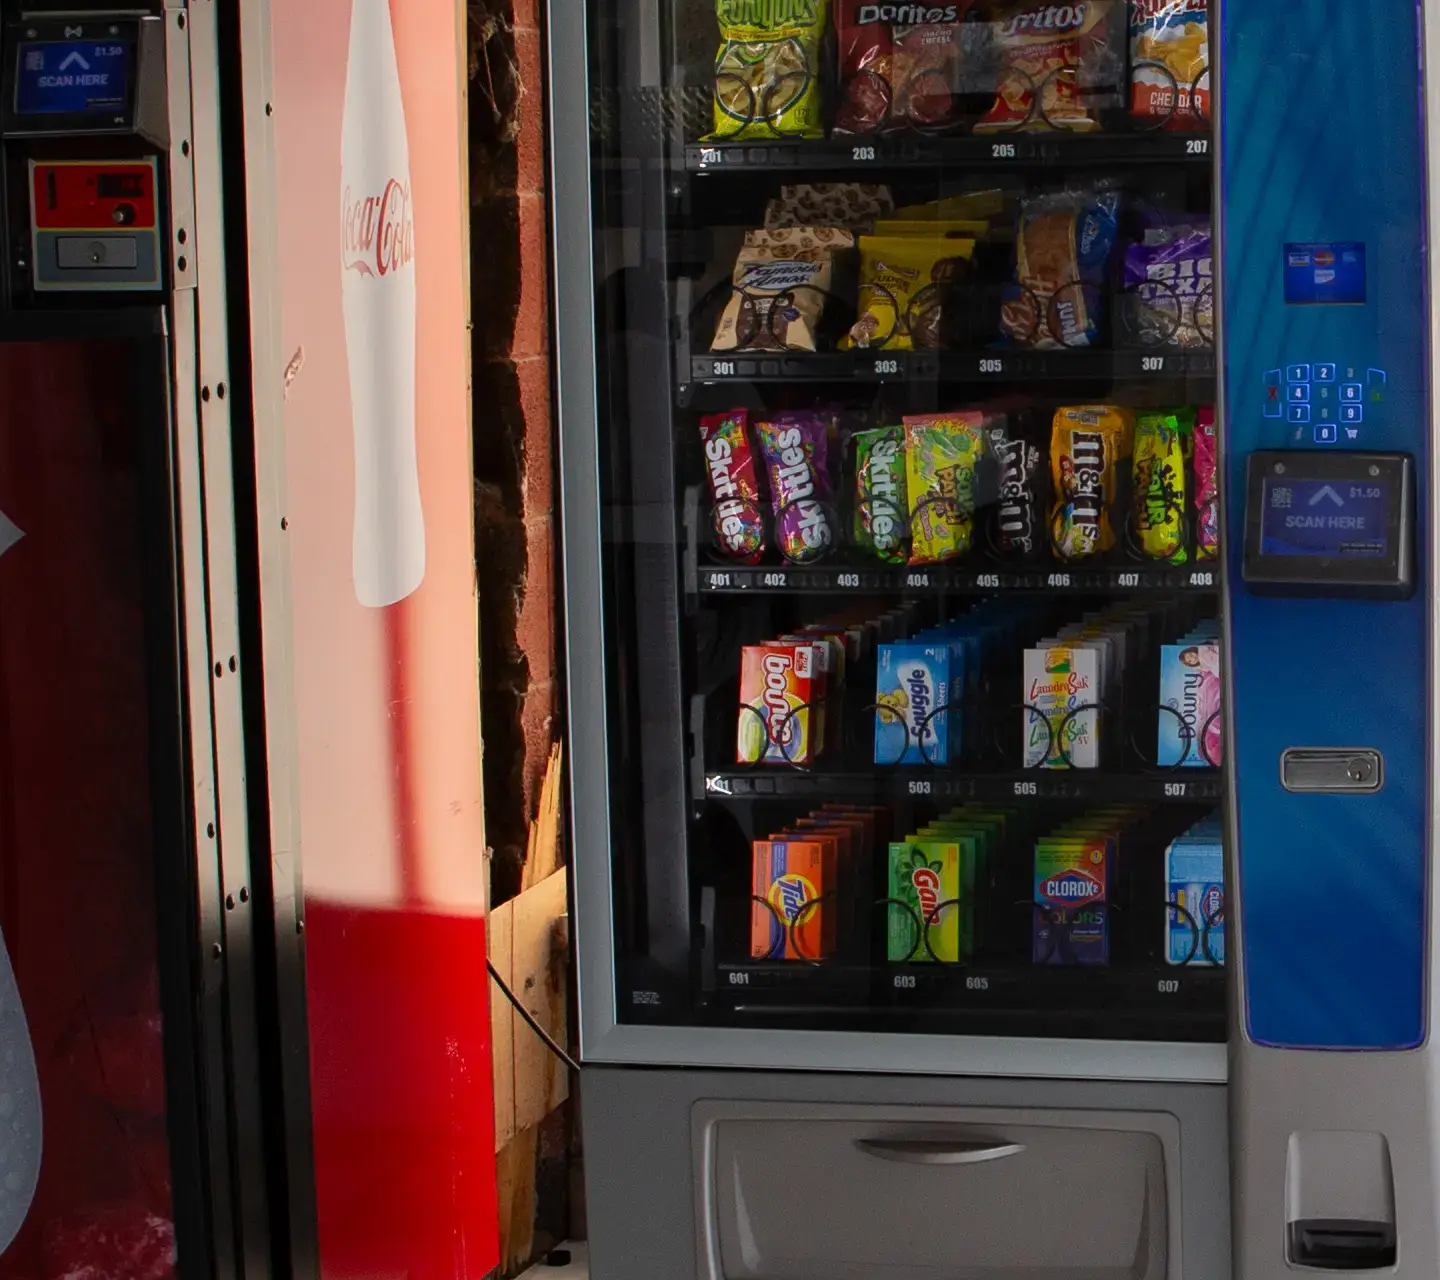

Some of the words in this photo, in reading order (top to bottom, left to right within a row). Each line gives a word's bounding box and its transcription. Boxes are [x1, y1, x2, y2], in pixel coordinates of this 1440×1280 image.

[858, 4, 957, 24] Doritos
[94, 47, 123, 57] $1.50
[38, 75, 73, 88] SCAN
[76, 74, 108, 86] HERE
[852, 147, 875, 160] 203
[992, 144, 1015, 158] 205
[1186, 140, 1208, 154] 207
[701, 150, 722, 163] 201
[713, 362, 735, 375] 301
[875, 360, 898, 373] 303
[979, 359, 1002, 372] 305
[1142, 357, 1164, 370] 307
[1295, 368, 1301, 378] 1
[1320, 368, 1327, 378] 2
[1295, 388, 1302, 398] 4
[1347, 388, 1354, 398] 6
[1295, 408, 1302, 418] 7
[1347, 408, 1354, 418] 9
[1321, 428, 1328, 438] 0
[705, 437, 745, 551] Skittles
[778, 428, 831, 548] Skittles
[870, 439, 898, 550] Skittles
[1350, 487, 1381, 498] $1.50
[1285, 515, 1324, 528] SCAN
[1329, 517, 1365, 529] HERE
[710, 574, 730, 587] 401
[764, 574, 786, 587] 402
[837, 574, 859, 587] 403
[907, 574, 929, 587] 404
[976, 574, 999, 587] 405
[1047, 574, 1070, 587] 406
[1118, 574, 1139, 587] 407
[1189, 573, 1213, 586] 408
[910, 669, 931, 739] Snuggle
[1177, 673, 1204, 740] Downy
[908, 781, 931, 794] 503
[1014, 782, 1037, 795] 505
[1164, 783, 1186, 796] 507
[777, 878, 804, 922] Tide
[912, 868, 941, 926] Gain
[729, 972, 749, 985] 601
[894, 976, 916, 988] 603
[966, 977, 989, 990] 605
[1158, 980, 1179, 993] 607
